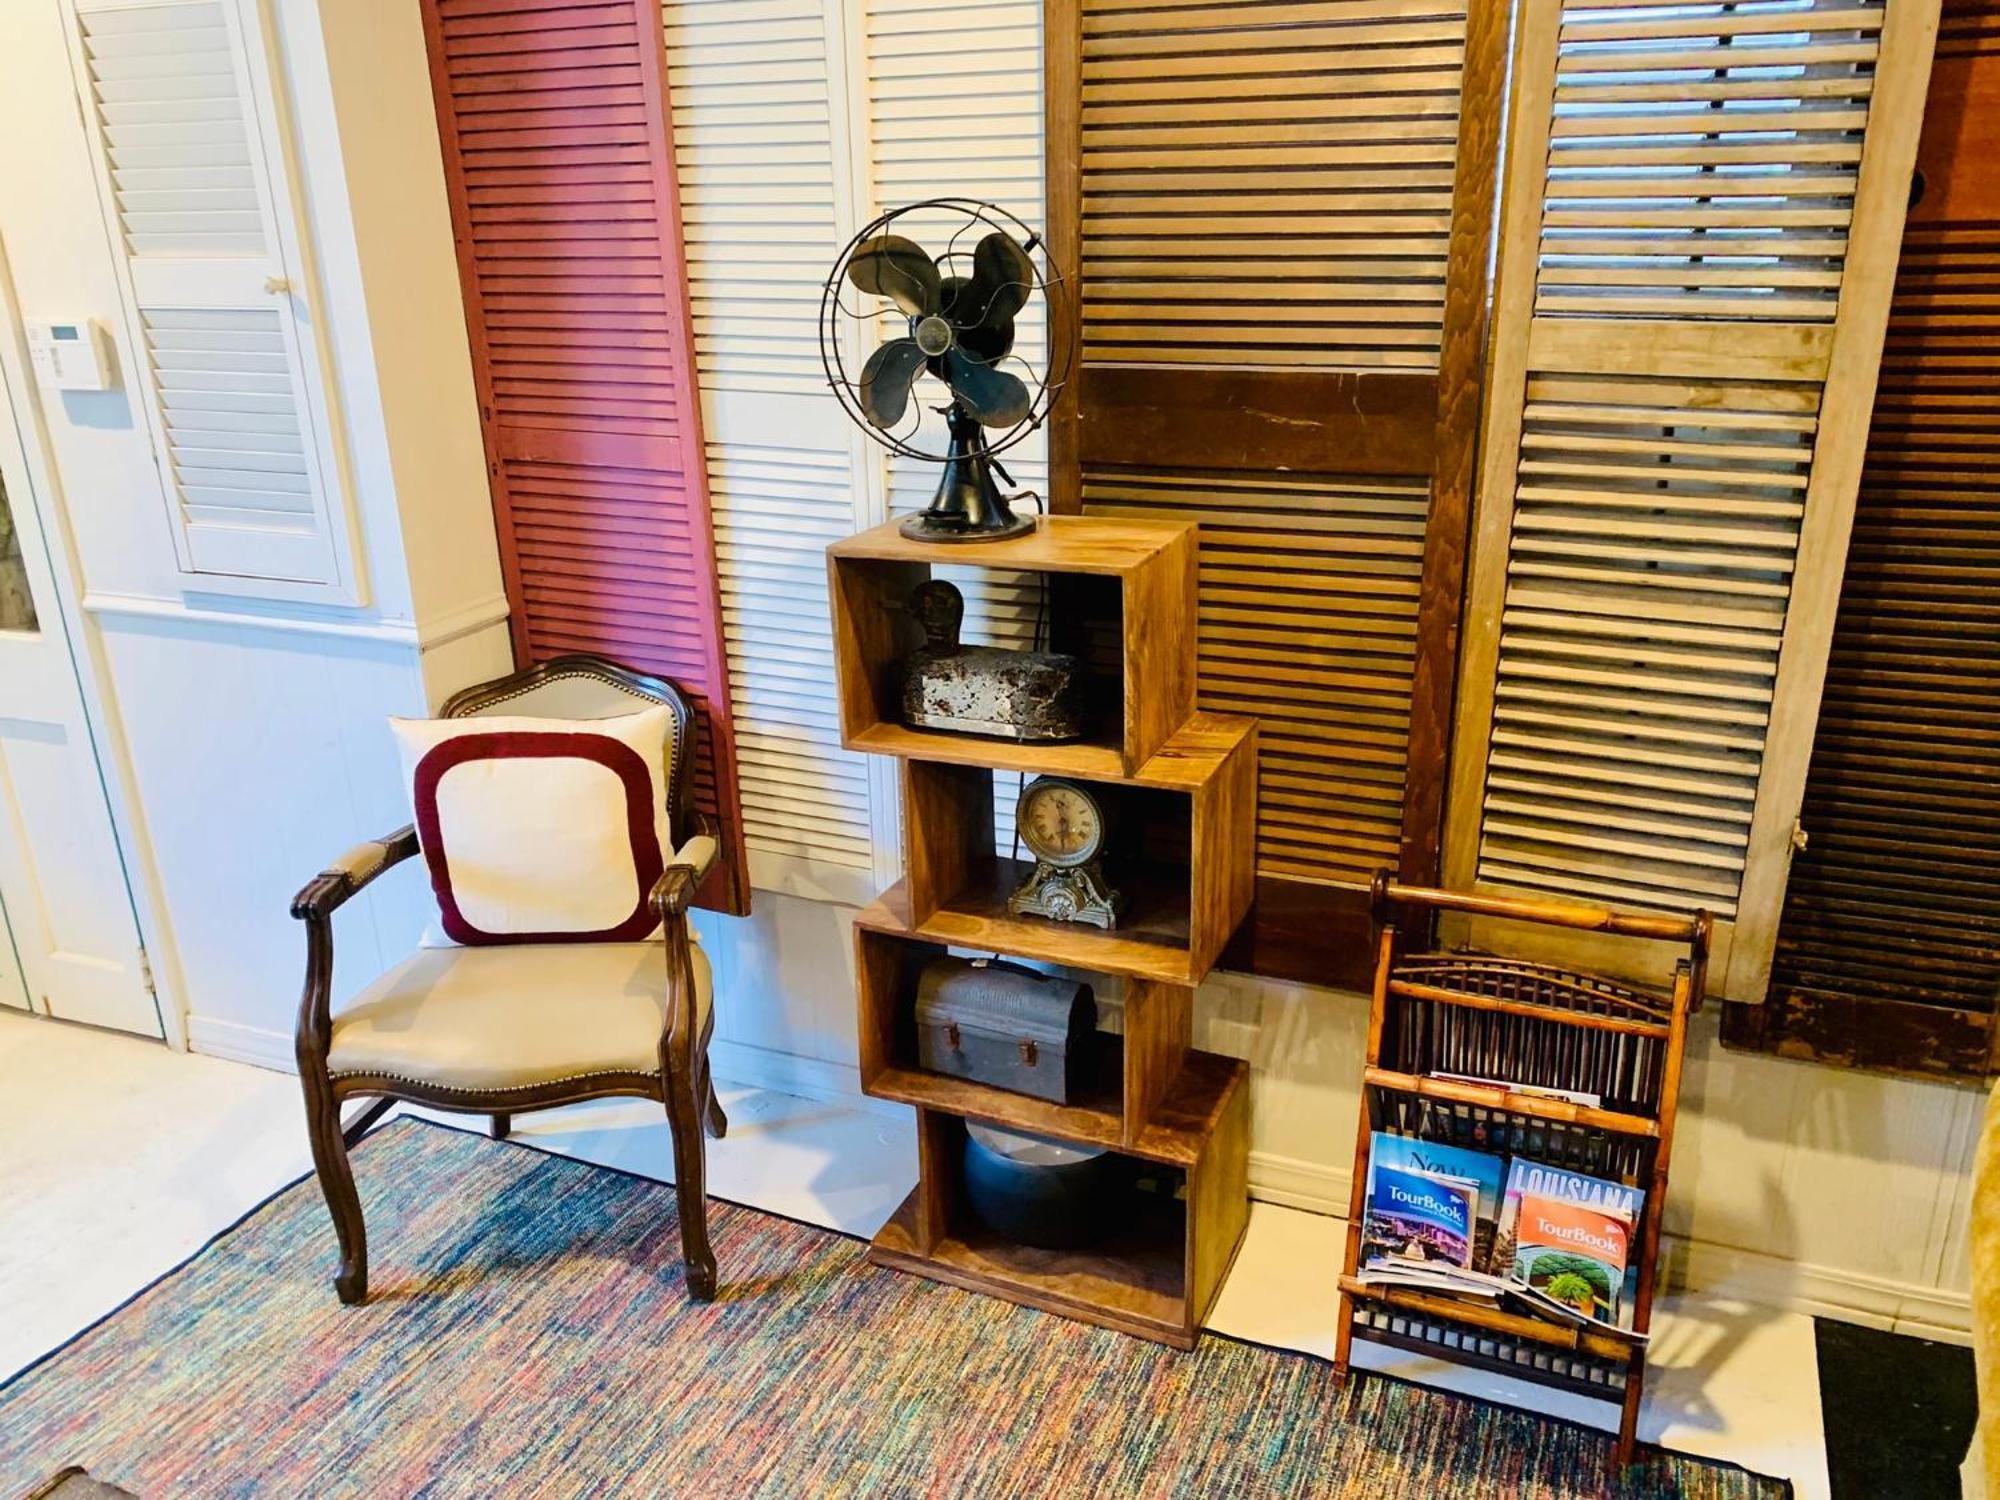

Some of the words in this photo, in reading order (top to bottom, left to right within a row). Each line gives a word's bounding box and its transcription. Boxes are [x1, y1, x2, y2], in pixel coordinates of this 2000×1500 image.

[1388, 1185, 1462, 1222] TourBook
[1514, 1164, 1633, 1210] LOUISIANA
[1536, 1216, 1619, 1253] TourBook
